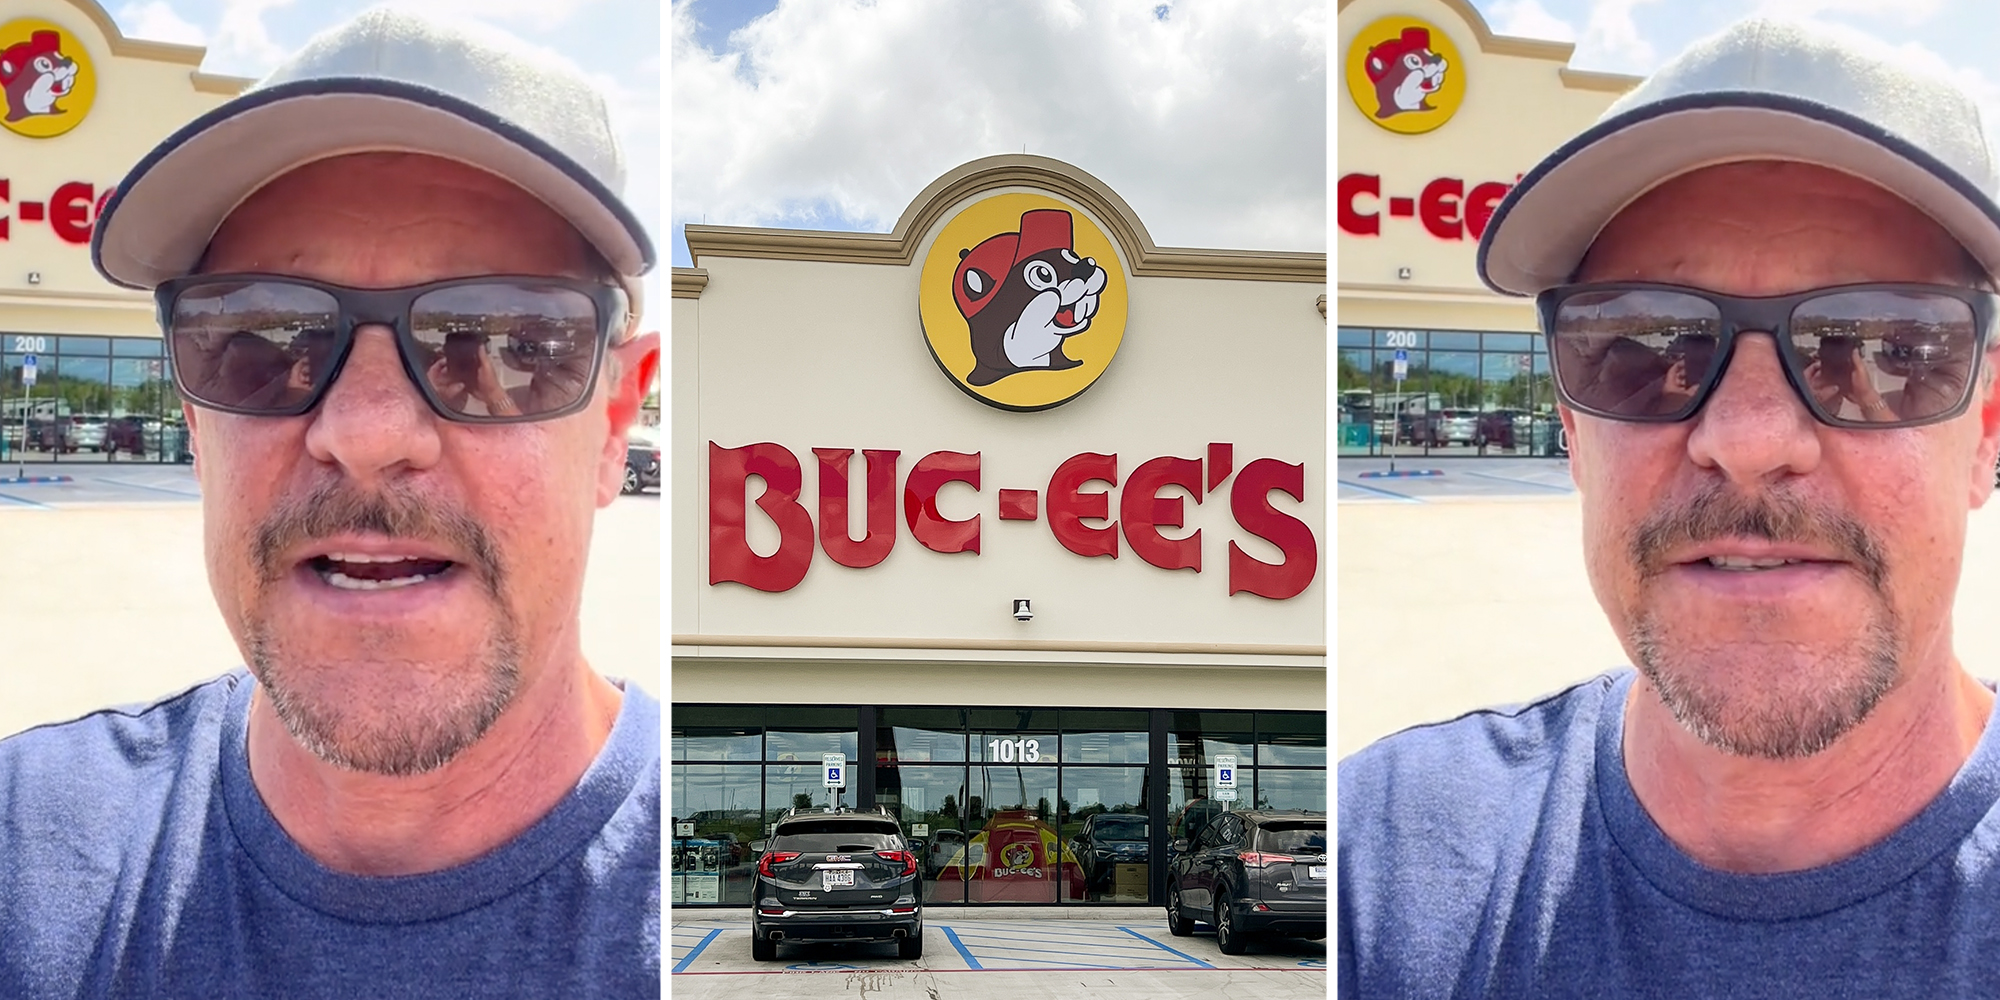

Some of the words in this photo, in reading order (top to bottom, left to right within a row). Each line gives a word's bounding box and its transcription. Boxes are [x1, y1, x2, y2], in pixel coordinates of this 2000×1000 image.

[15, 335, 46, 353] 200
[1386, 330, 1417, 348] 200
[709, 440, 1318, 601] BUC-EE'S
[988, 739, 1040, 763] 1013
